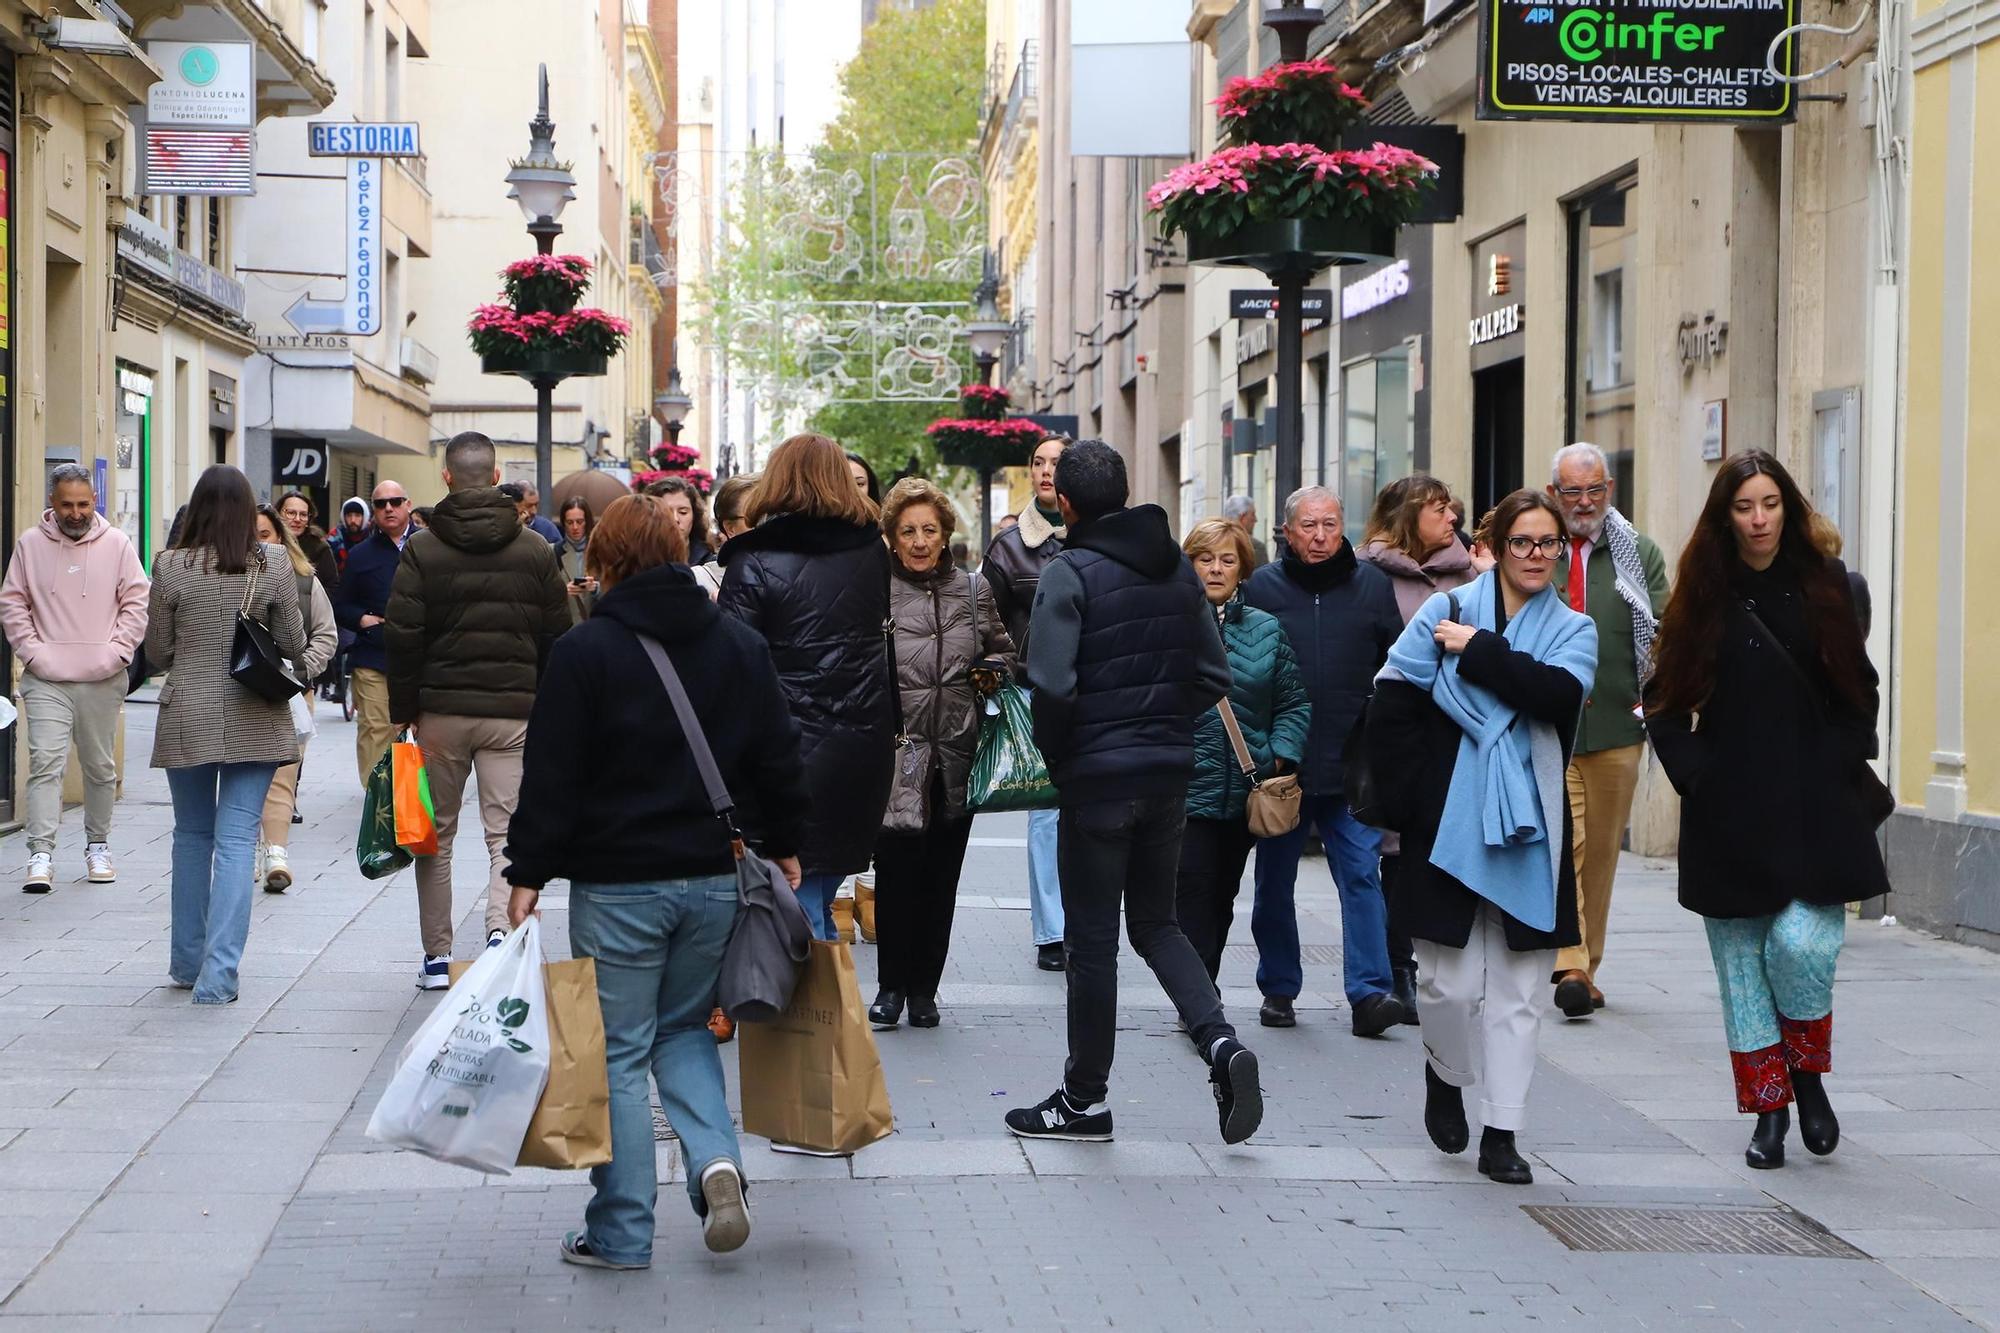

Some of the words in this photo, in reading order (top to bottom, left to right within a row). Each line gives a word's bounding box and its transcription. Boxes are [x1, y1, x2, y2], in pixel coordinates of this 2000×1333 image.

[1559, 8, 1725, 62] Coinfer
[1507, 63, 1775, 86] PISOS-LOCALES-CHALETS
[1534, 84, 1748, 107] VENTAS-ALQUILERES
[312, 126, 414, 152] GESTORIA
[358, 237, 371, 333] redondo
[1239, 299, 1271, 309] JACK
[1302, 299, 1323, 310] NES
[1469, 303, 1519, 346] SCALPERS
[282, 448, 322, 476] JD
[448, 1052, 484, 1067] MICRAS
